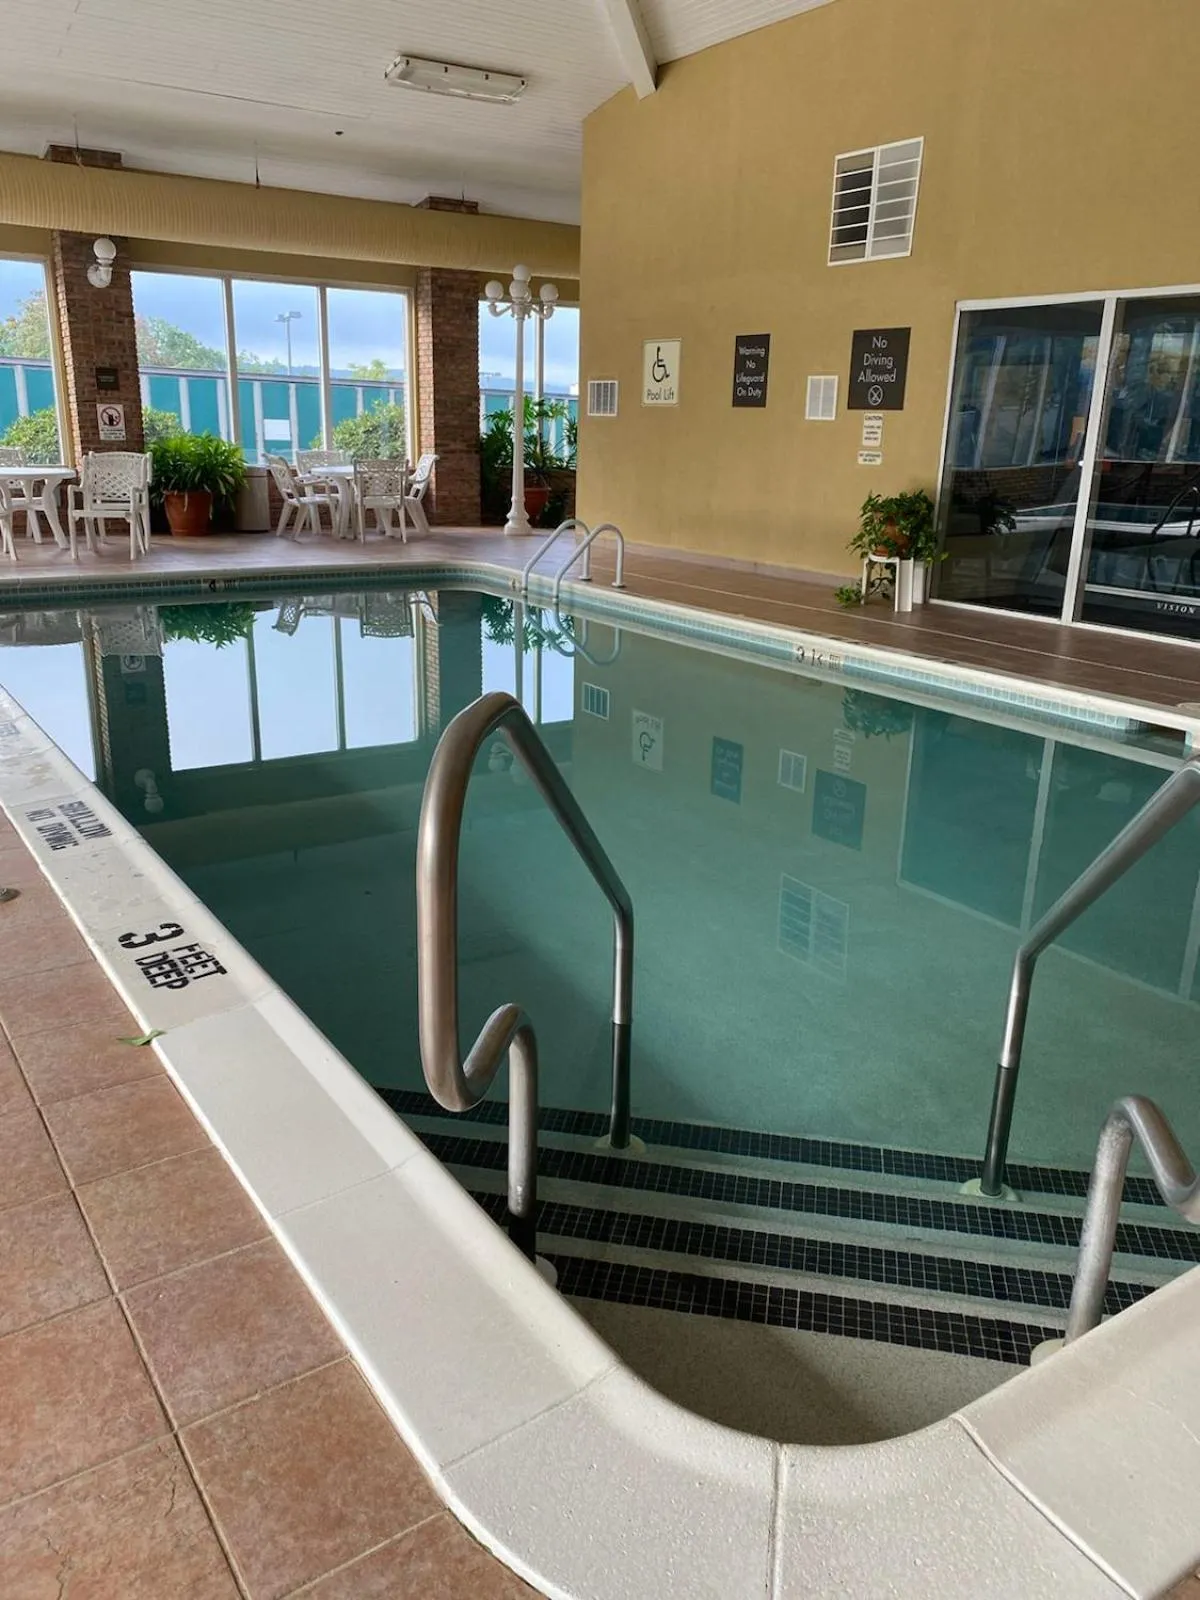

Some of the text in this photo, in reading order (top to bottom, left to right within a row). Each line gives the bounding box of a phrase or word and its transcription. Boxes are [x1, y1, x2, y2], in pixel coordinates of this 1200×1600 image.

[871, 335, 888, 349] No
[738, 346, 766, 358] Warning
[745, 359, 756, 369] No
[863, 352, 894, 369] Diving
[735, 371, 766, 386] Lifeguard
[857, 367, 897, 383] Allowed
[647, 386, 674, 401] Pool Lift
[736, 386, 762, 399] On Duty
[1156, 602, 1196, 614] VISION
[25, 808, 57, 822] NO
[57, 800, 113, 840] SHALLOW
[118, 923, 184, 949] 3
[172, 943, 228, 980] FEET
[134, 951, 189, 990] DEEP
